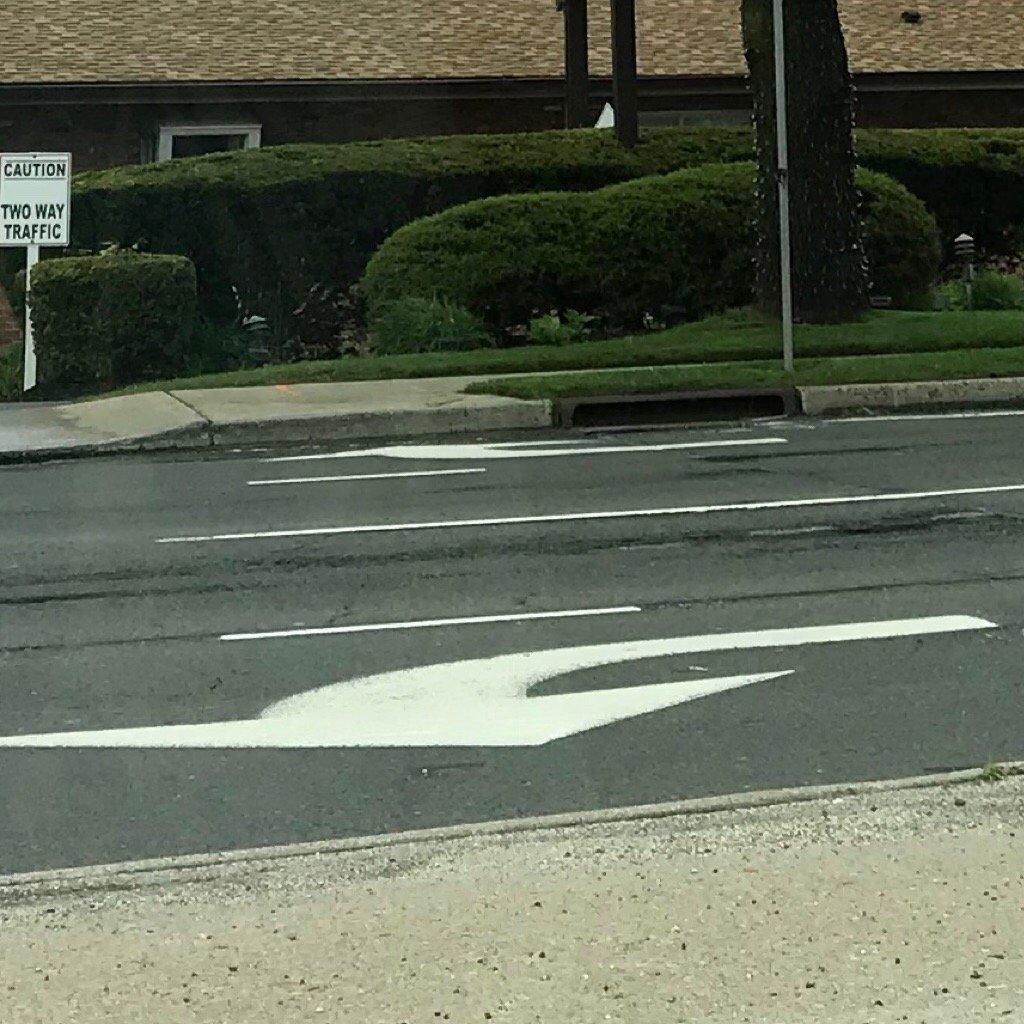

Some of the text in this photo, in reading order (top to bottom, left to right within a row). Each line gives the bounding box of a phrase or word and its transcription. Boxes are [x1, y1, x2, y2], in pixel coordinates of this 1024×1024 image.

[4, 163, 66, 177] CAUTION
[0, 203, 65, 220] TWO WAY
[4, 223, 62, 239] TRAFFIC
